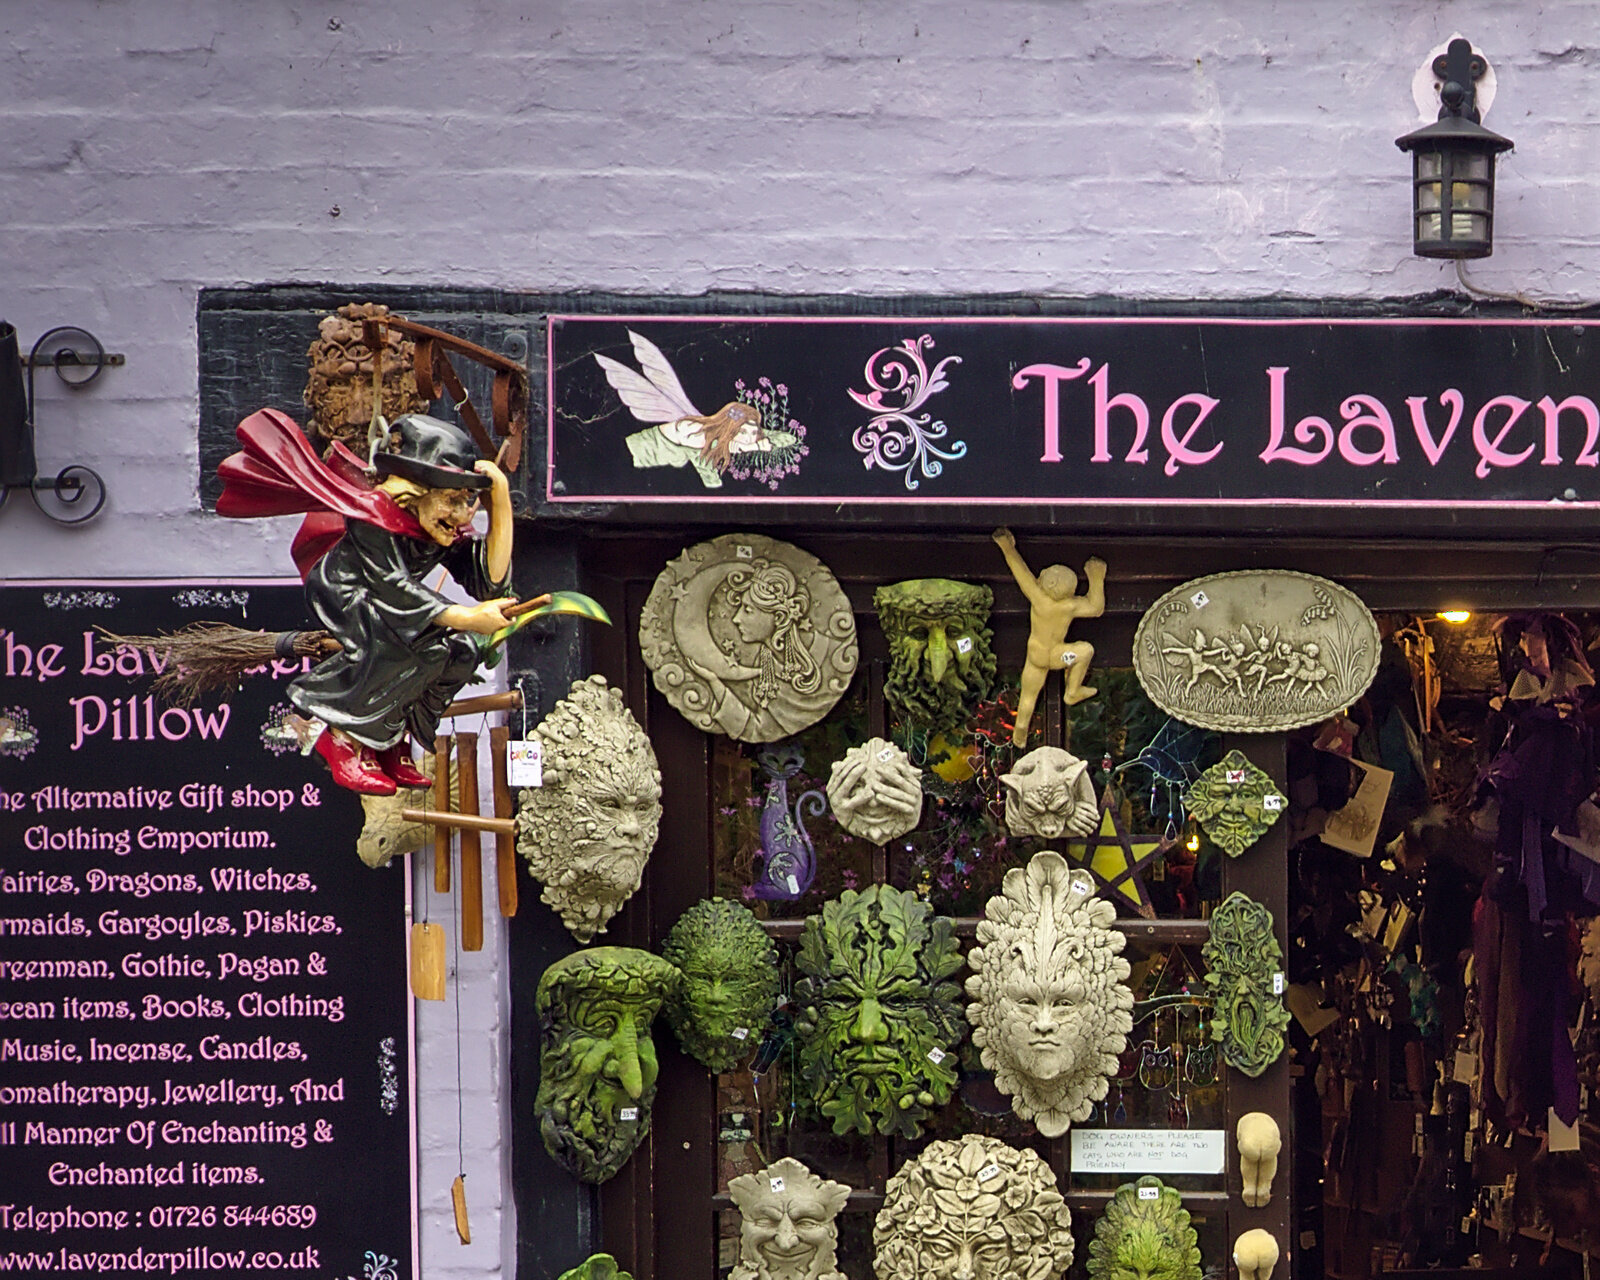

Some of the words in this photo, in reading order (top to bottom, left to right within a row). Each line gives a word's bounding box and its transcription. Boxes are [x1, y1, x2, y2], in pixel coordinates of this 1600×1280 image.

[1011, 356, 1224, 478] The
[0, 628, 66, 682] he
[69, 695, 231, 750] Pillow
[31, 784, 172, 812] Alternative
[179, 783, 223, 813] Gift
[231, 784, 294, 812] shop
[301, 783, 321, 806] &
[24, 826, 131, 856] Clothing
[138, 826, 276, 853] Emporium.
[86, 869, 203, 897] Dragons,
[210, 868, 317, 892] Witches,
[99, 910, 237, 940] Gargoyles,
[244, 909, 343, 938] Piskies,
[122, 952, 211, 979] Gothic,
[218, 952, 299, 981] Pagan
[307, 952, 327, 976] &
[63, 996, 137, 1021] items,
[142, 995, 231, 1021] Books,
[238, 992, 345, 1022] Clothing
[1, 1039, 82, 1062] Music,
[90, 1038, 193, 1062] Incense,
[199, 1035, 308, 1062] Candles,
[162, 1079, 284, 1108] Jewellery,
[290, 1078, 344, 1101] And
[24, 1122, 120, 1146] Manner
[127, 1120, 155, 1149] Of
[162, 1119, 306, 1148] Enchanting
[313, 1119, 333, 1144] &
[49, 1162, 184, 1187] Enchanted
[192, 1163, 265, 1187] items.
[0, 1205, 129, 1232] Telephone
[150, 1206, 216, 1228] 01726
[223, 1204, 317, 1229] 844689
[0, 1247, 320, 1275] www.lavenderpillow.co.uk
